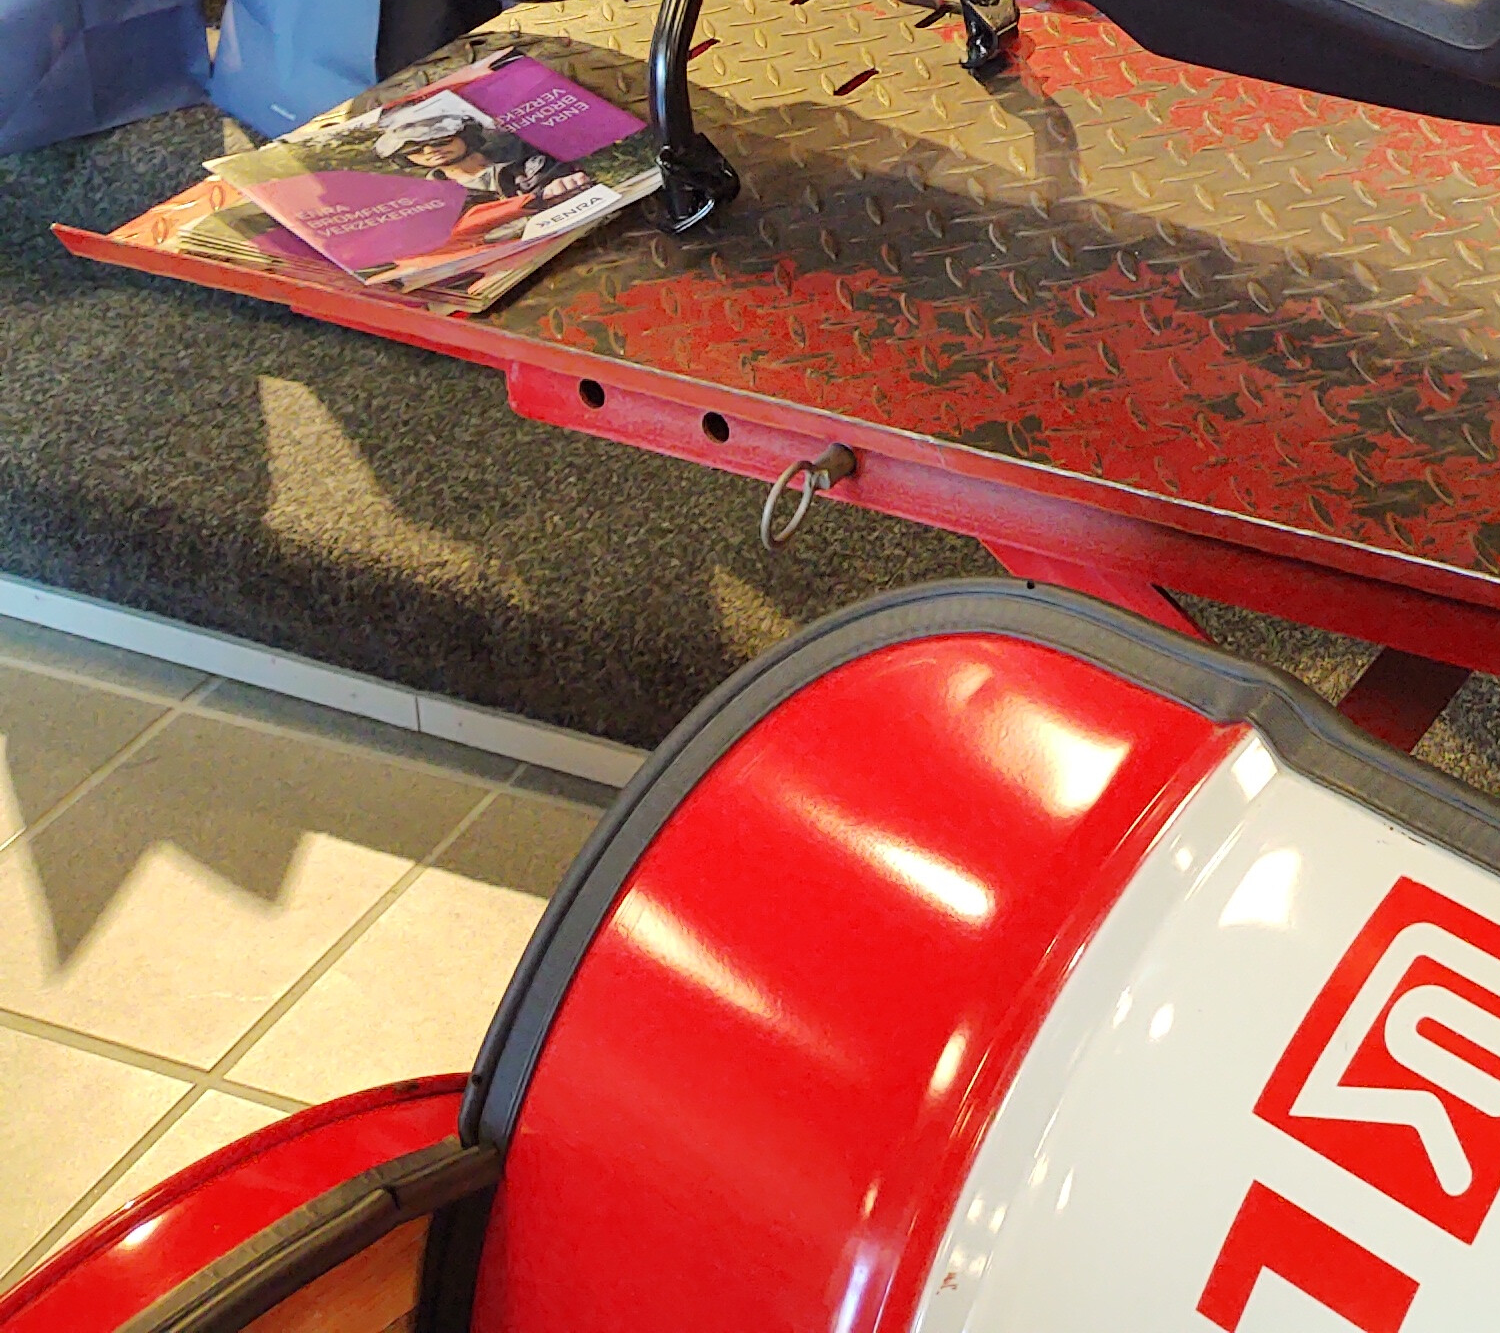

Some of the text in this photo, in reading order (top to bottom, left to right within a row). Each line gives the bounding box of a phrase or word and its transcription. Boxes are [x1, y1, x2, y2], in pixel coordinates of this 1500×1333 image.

[541, 101, 590, 128] ENRA
[296, 204, 349, 221] ENRA
[307, 197, 418, 229] BROMFIETS-
[317, 199, 446, 238] VERZEKERING
[550, 196, 603, 223] ENRA
